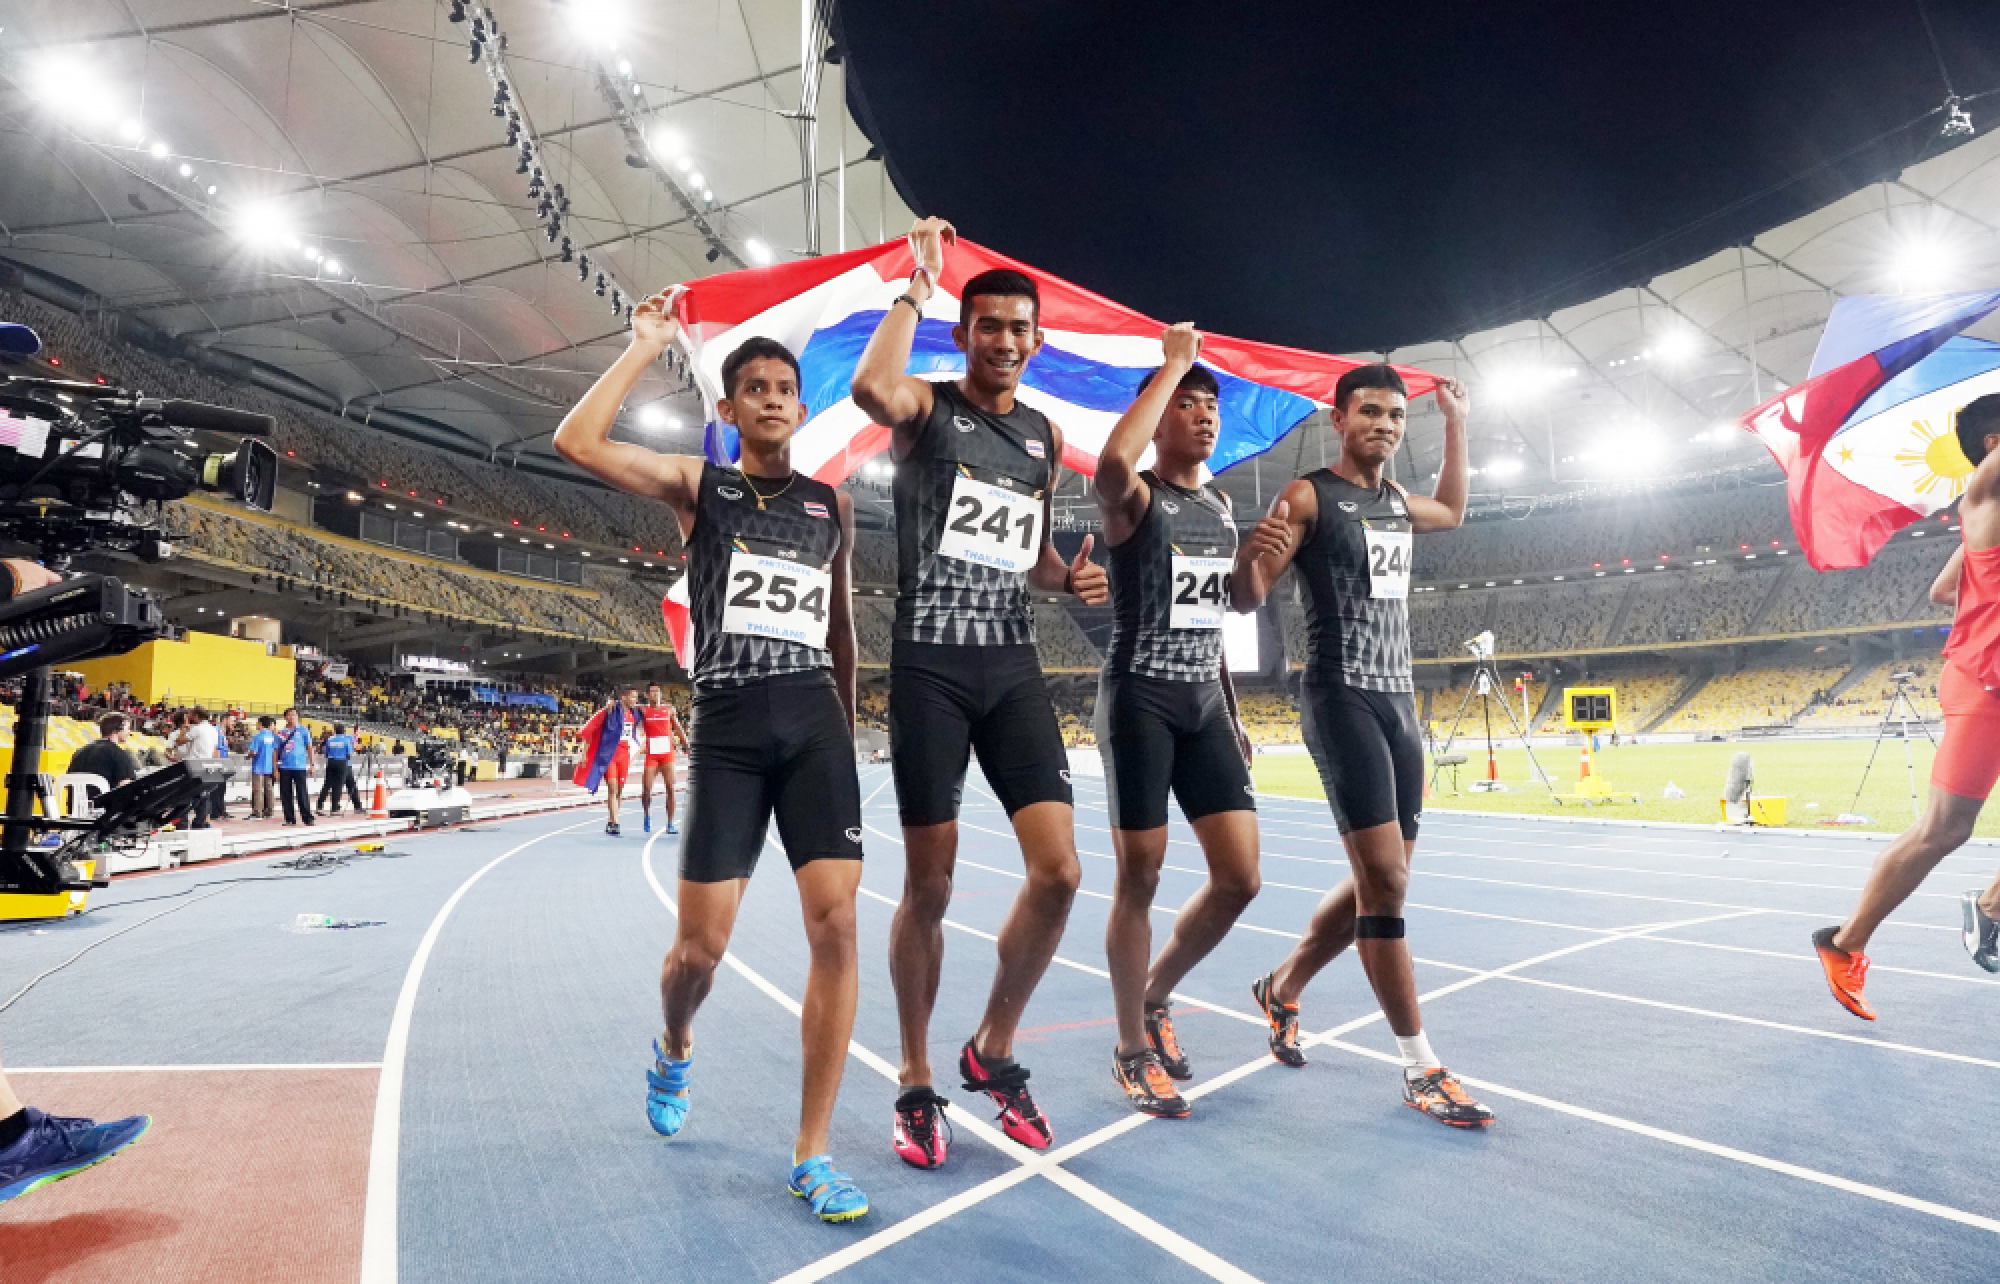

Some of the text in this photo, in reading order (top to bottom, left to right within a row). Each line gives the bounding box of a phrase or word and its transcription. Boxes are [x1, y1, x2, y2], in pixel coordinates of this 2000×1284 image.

[949, 495, 1035, 551] 241
[963, 549, 1016, 569] THAILAND
[728, 569, 826, 623] 254
[746, 621, 807, 640] THAILAND
